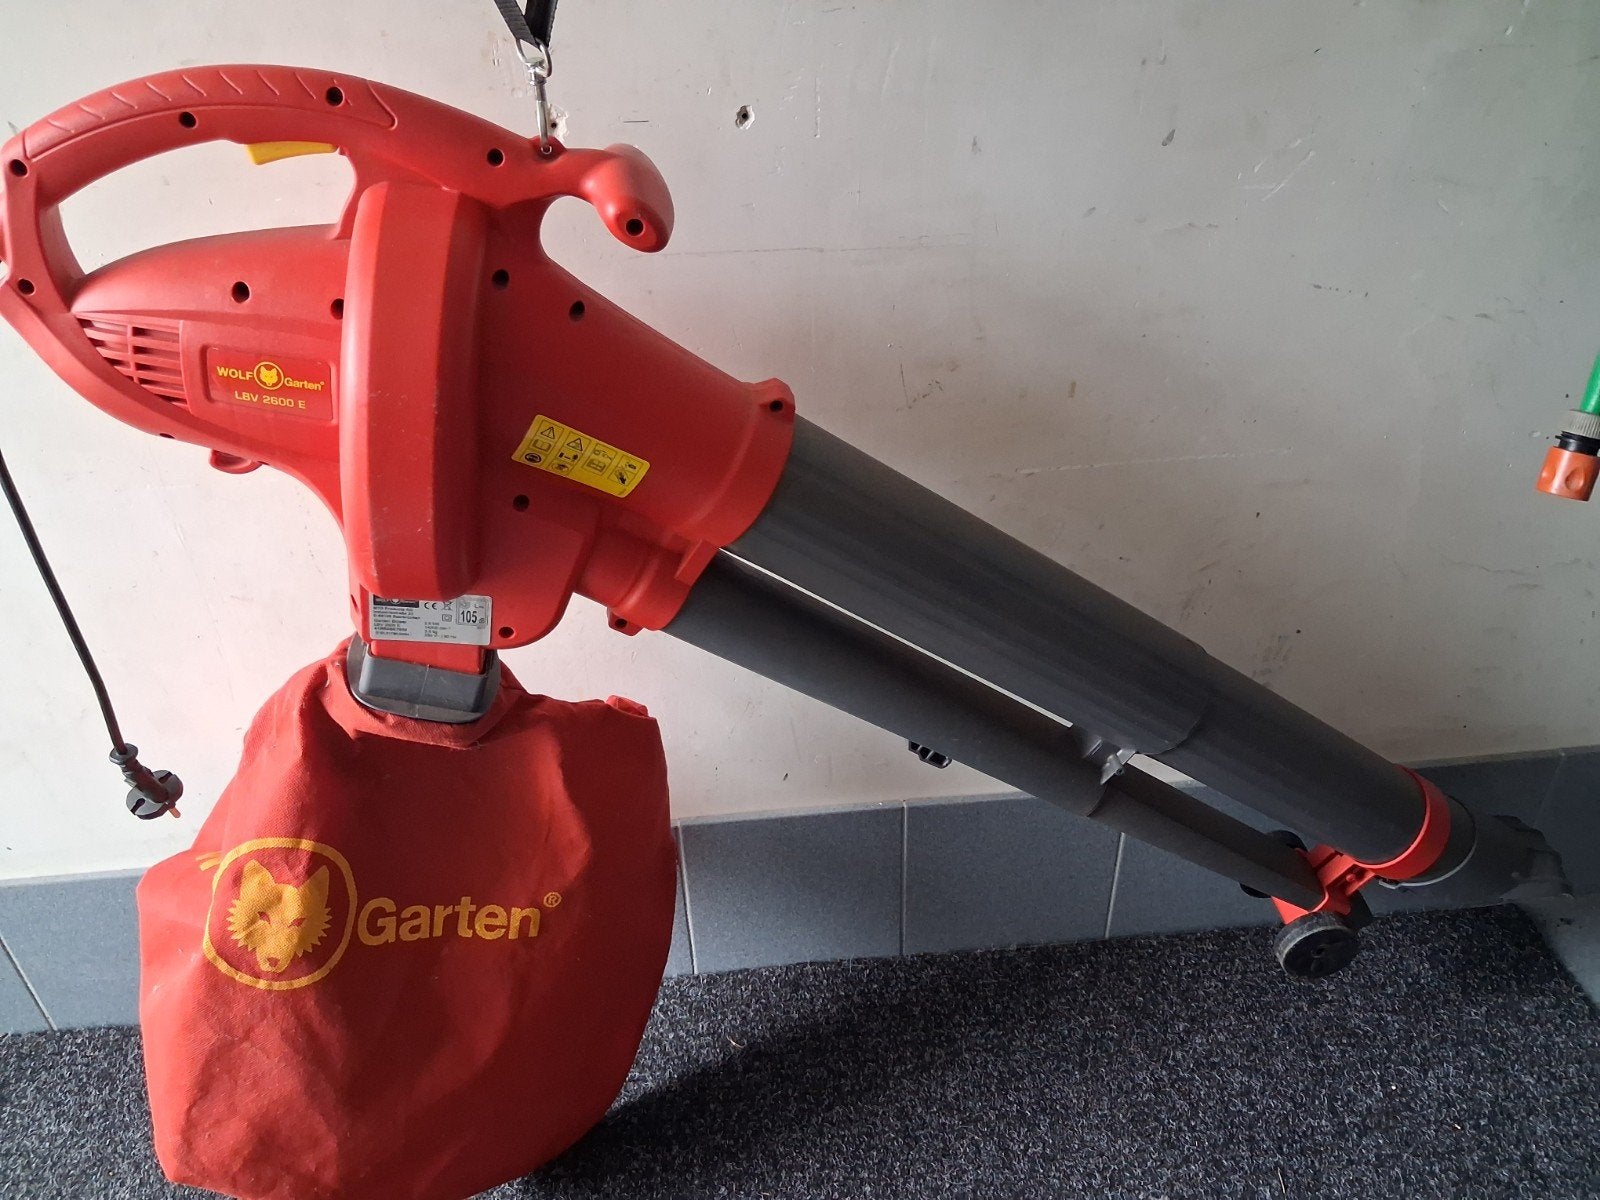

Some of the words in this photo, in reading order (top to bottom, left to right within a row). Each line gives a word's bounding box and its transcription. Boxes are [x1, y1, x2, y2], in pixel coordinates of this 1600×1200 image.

[216, 366, 254, 381] WOLF
[234, 390, 258, 402] LBV
[262, 394, 295, 408] 2600
[298, 400, 306, 409] E
[461, 610, 478, 624] 105
